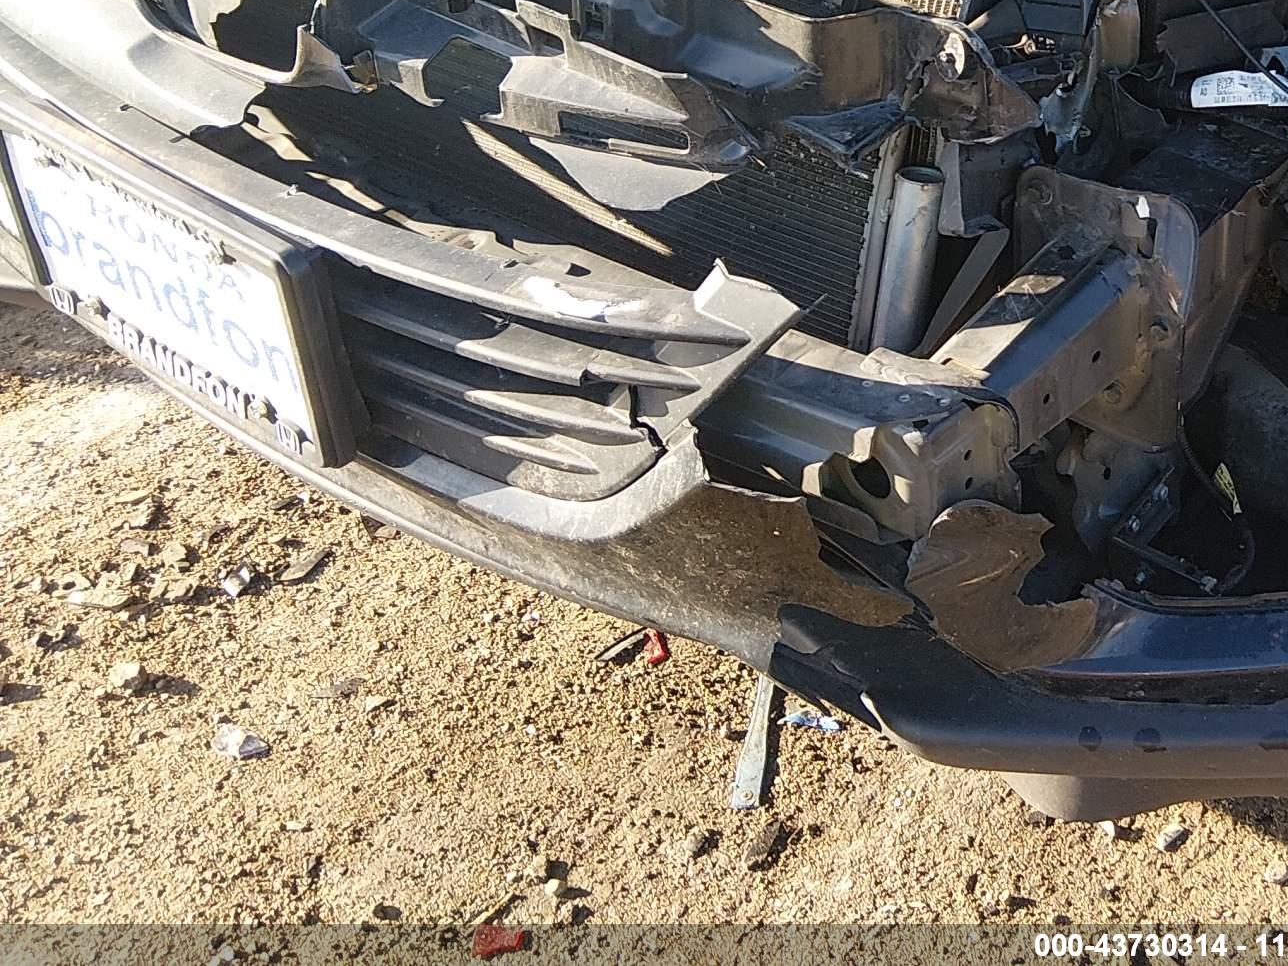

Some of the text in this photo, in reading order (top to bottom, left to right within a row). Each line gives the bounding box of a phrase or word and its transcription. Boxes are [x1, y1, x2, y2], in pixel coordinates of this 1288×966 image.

[24, 187, 302, 394] brandfon
[86, 193, 247, 304] HONDA
[107, 316, 250, 421] BRANDFON
